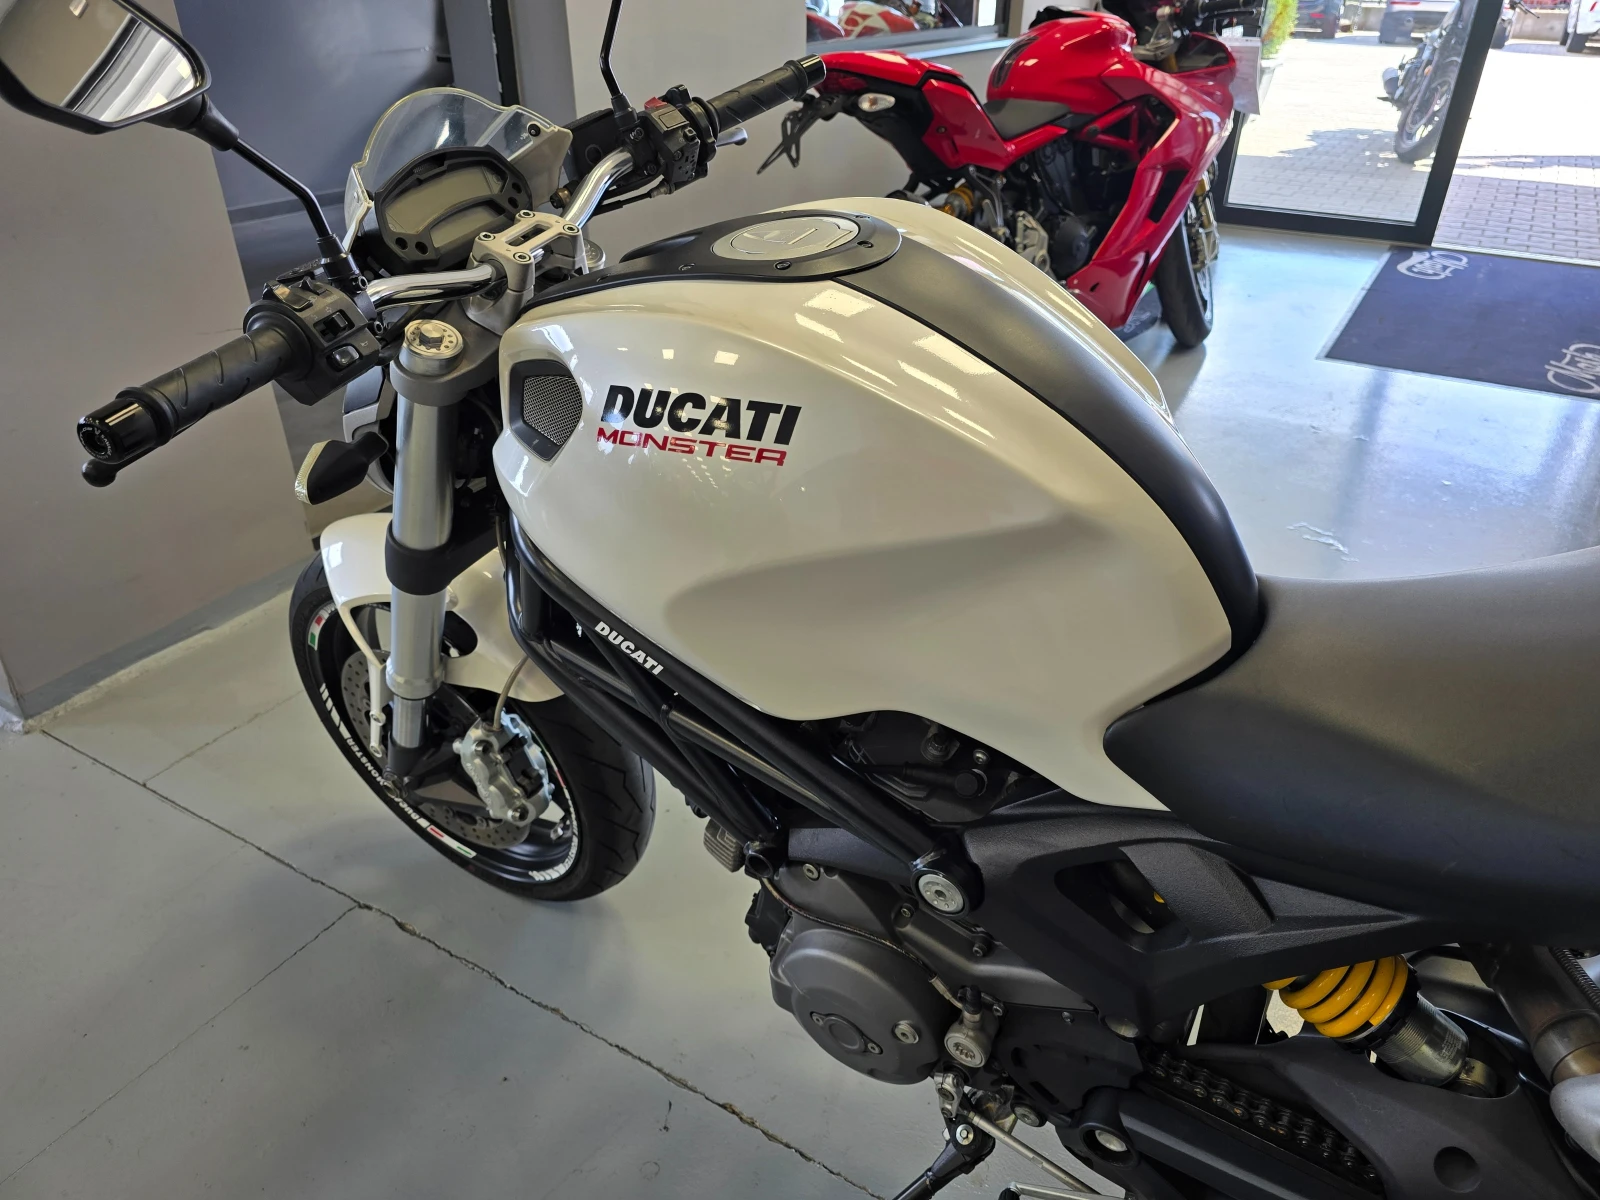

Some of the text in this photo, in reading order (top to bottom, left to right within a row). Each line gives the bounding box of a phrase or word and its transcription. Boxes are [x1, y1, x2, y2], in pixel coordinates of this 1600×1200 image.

[600, 384, 802, 445] DUCATI
[596, 427, 787, 466] MONSTER
[594, 620, 664, 675] DUCATI
